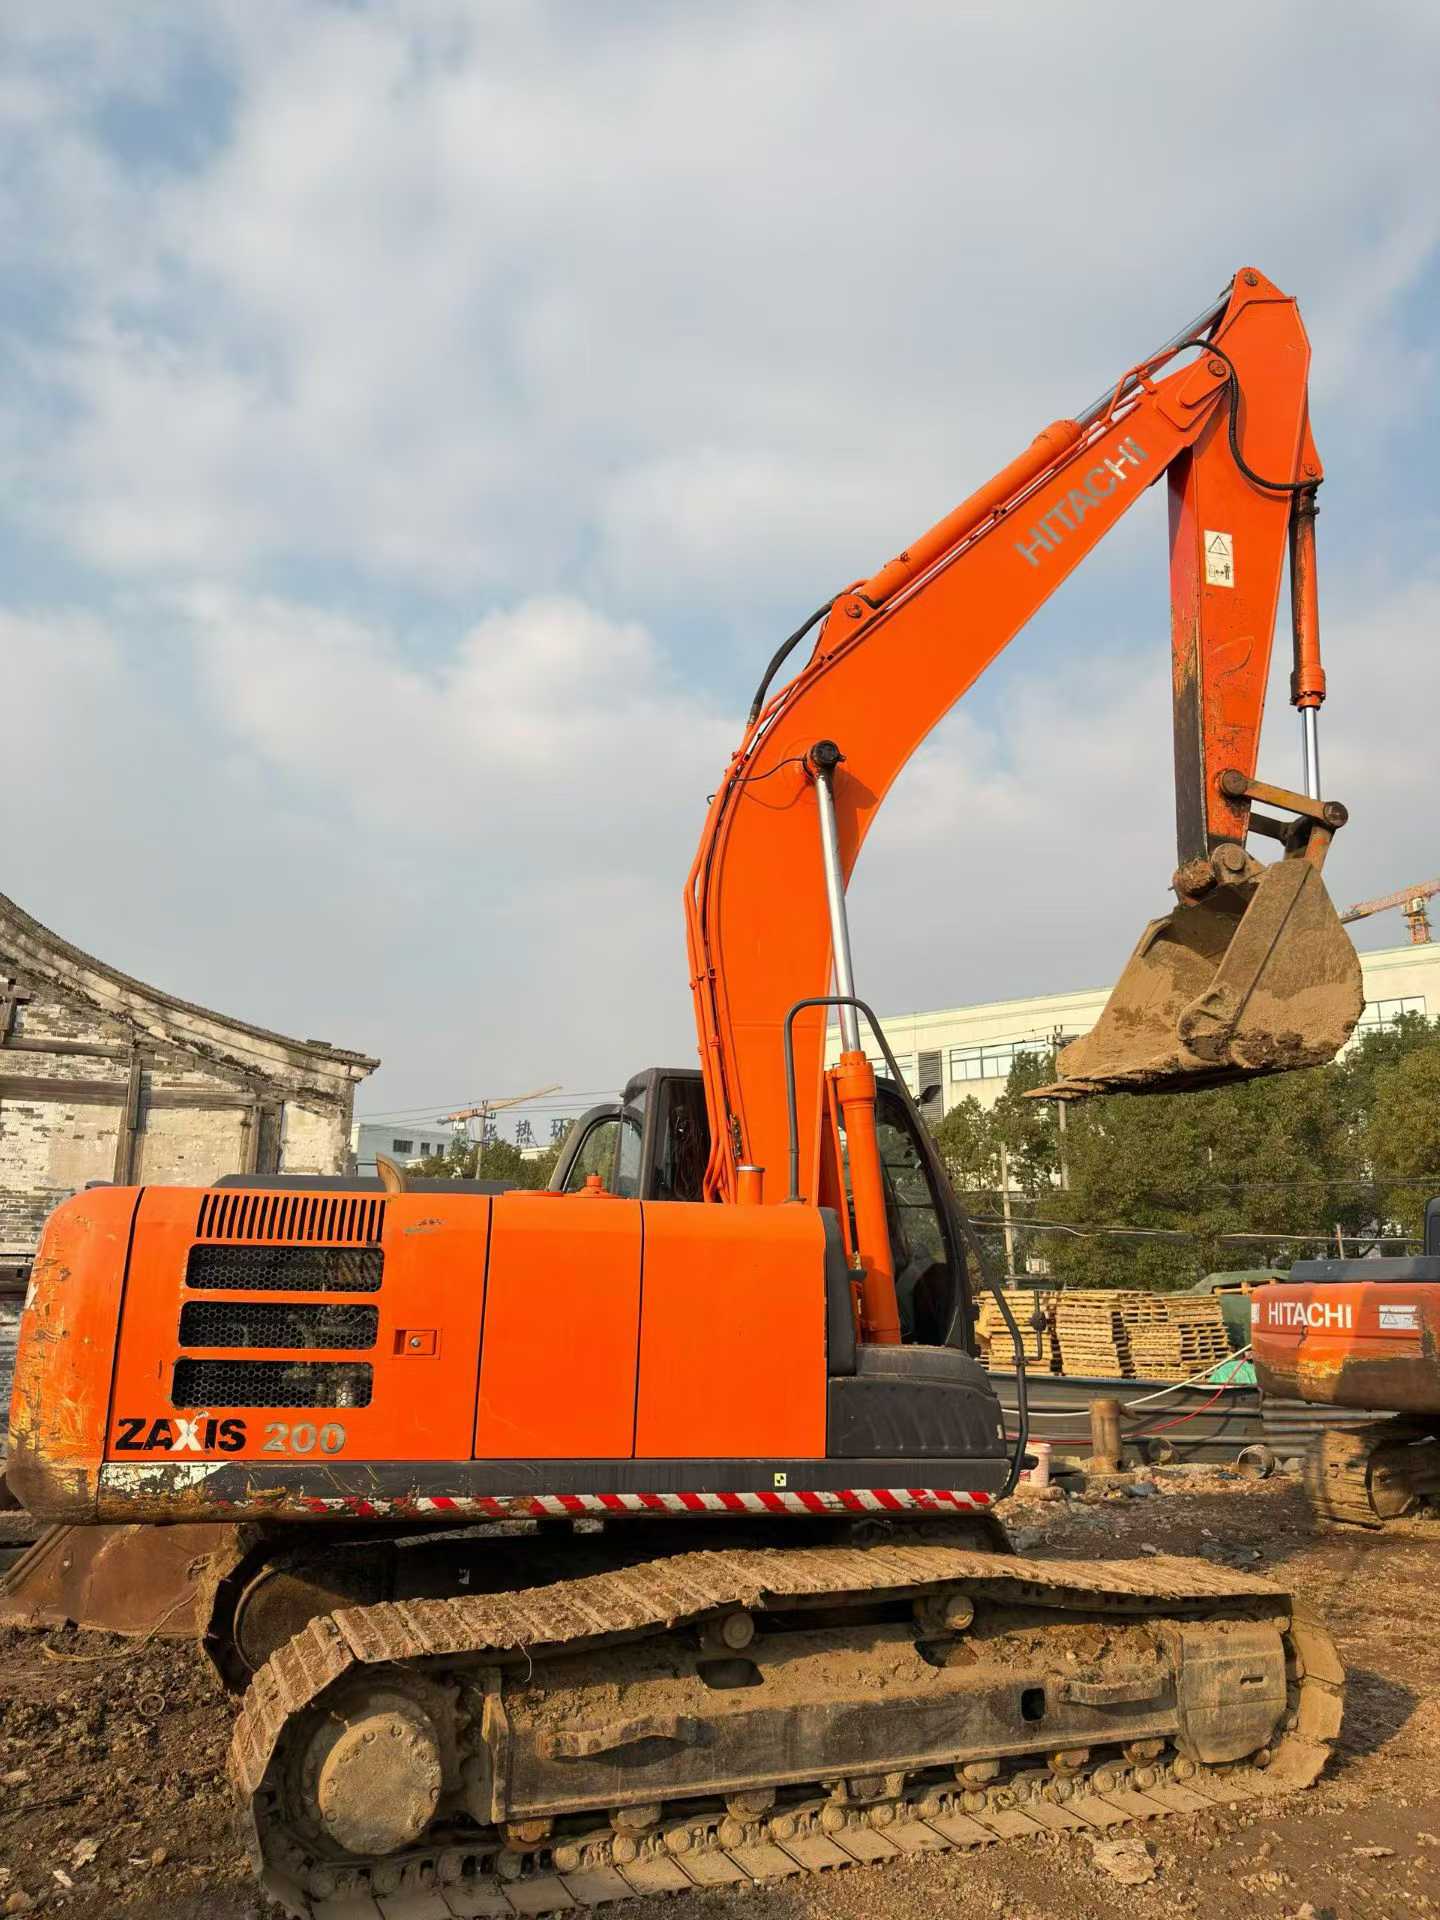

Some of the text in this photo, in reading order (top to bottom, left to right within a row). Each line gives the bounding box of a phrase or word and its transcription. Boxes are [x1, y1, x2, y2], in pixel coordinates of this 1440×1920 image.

[1013, 436, 1147, 567] HITACHI
[1268, 1302, 1352, 1329] HITACHI
[115, 1418, 347, 1455] ZAXIS 200
